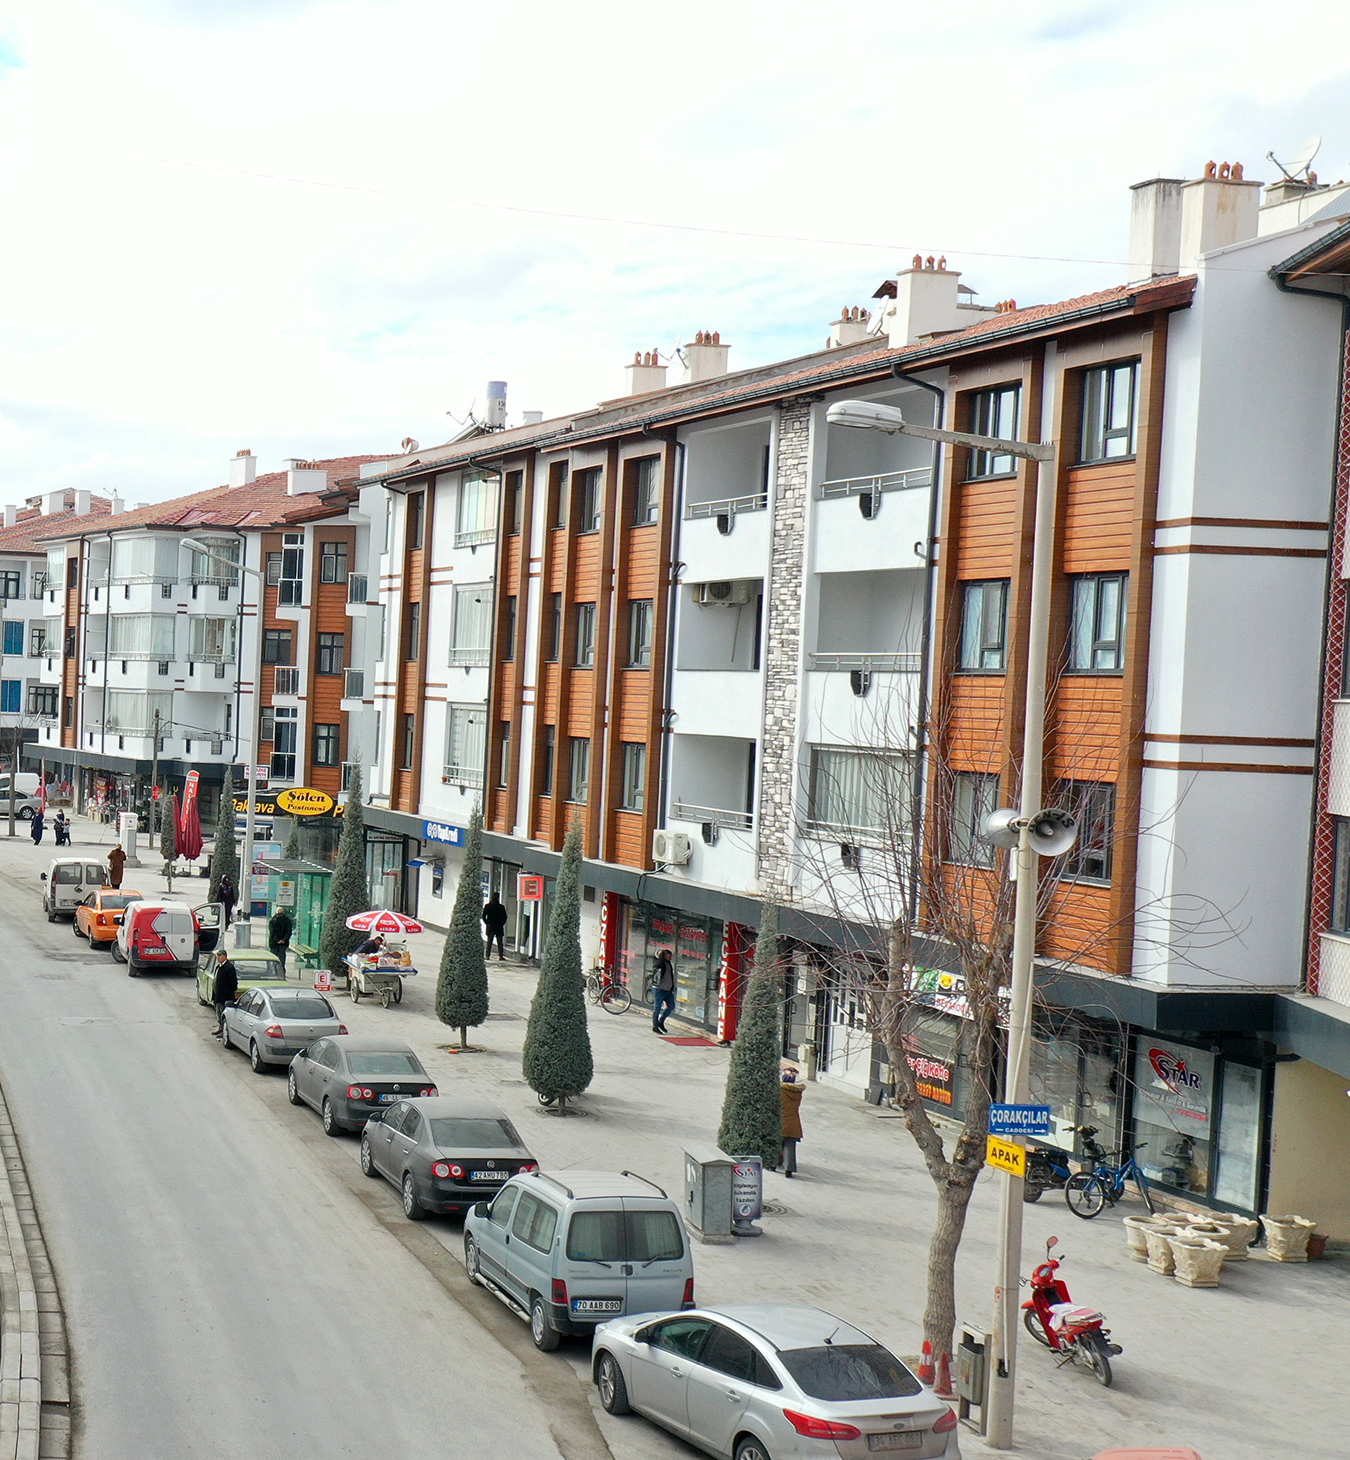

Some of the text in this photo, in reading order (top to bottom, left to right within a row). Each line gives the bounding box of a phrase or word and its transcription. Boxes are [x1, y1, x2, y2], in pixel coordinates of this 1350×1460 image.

[287, 790, 326, 804] Şölen
[233, 798, 276, 814] Bakava
[524, 880, 539, 896] E
[716, 921, 730, 1040] ECZANE
[1157, 1059, 1201, 1090] STAR
[990, 1109, 1048, 1127] ÇORAKÇILAR
[991, 1147, 1020, 1166] APAK
[577, 1301, 619, 1310] 70 AAB 690
